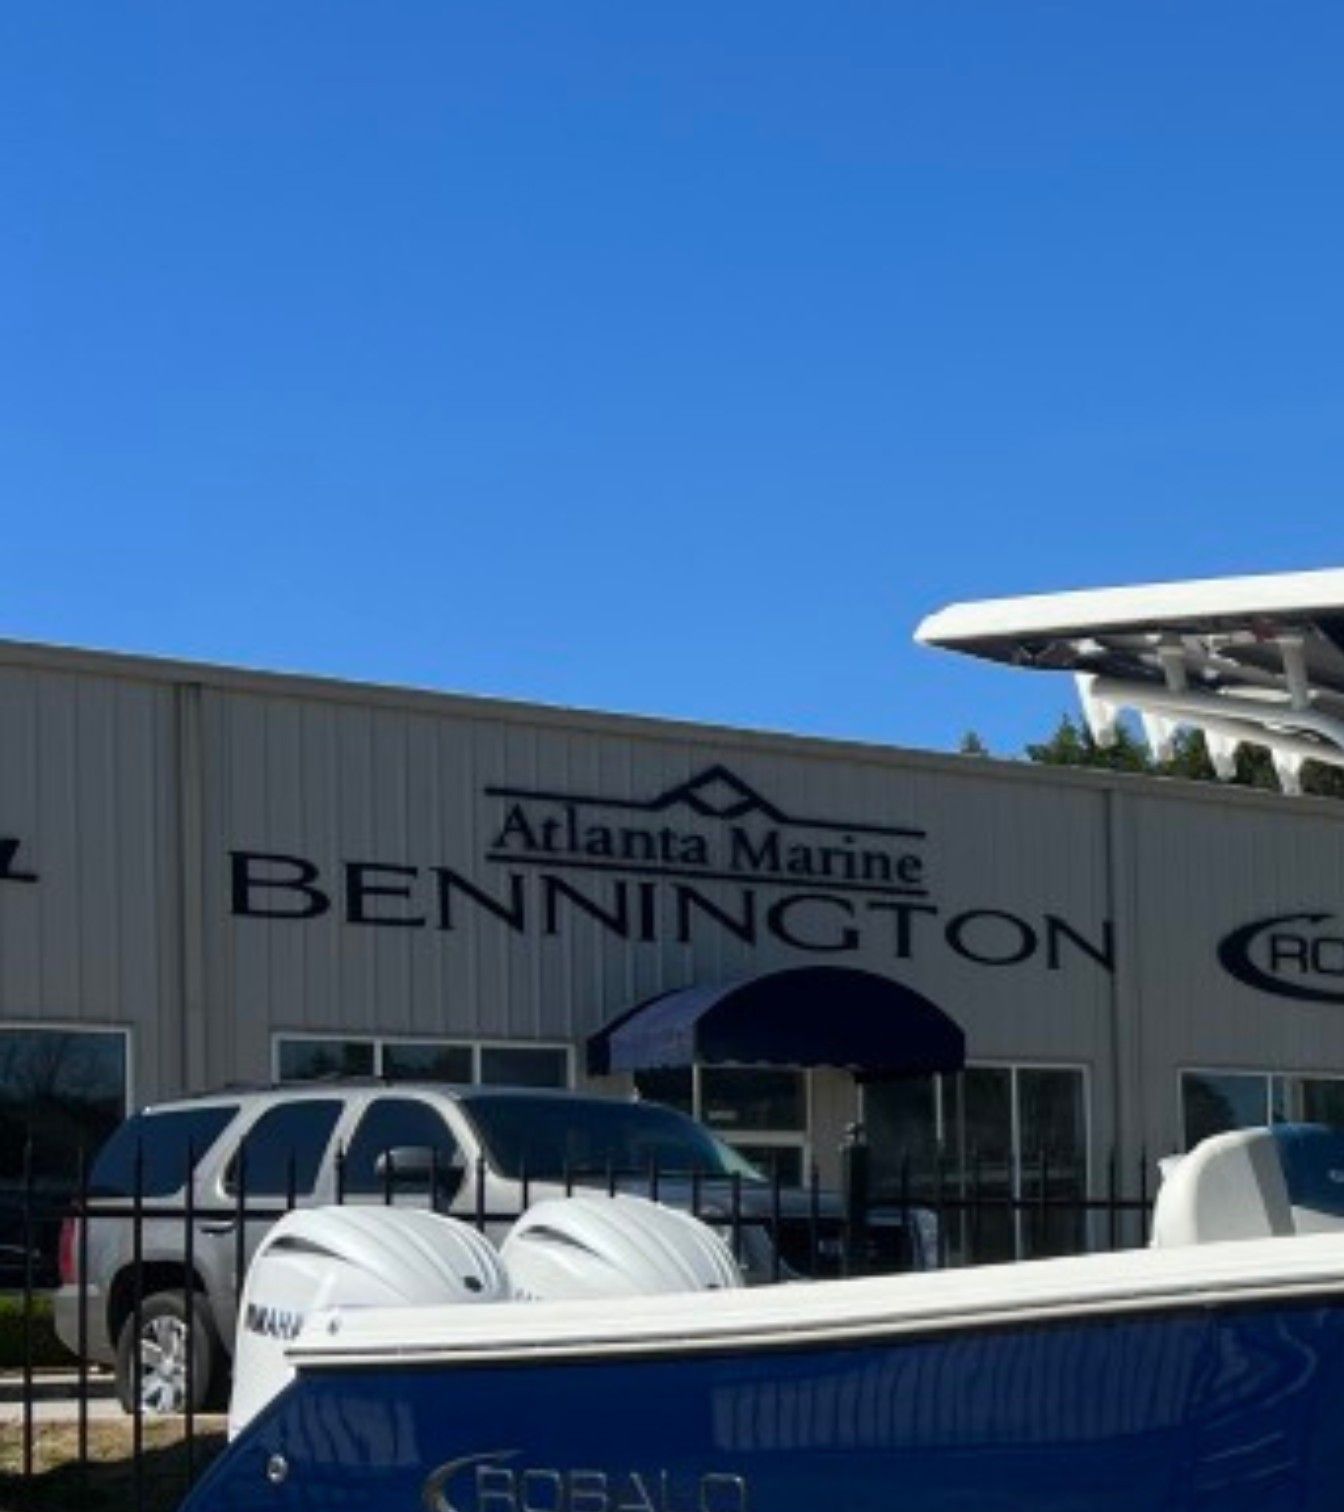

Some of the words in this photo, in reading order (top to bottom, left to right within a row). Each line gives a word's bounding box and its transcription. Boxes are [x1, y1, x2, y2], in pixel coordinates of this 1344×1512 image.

[493, 803, 708, 867] Atlanta
[730, 826, 924, 885] Marine
[228, 850, 1116, 976] BENNINGTON
